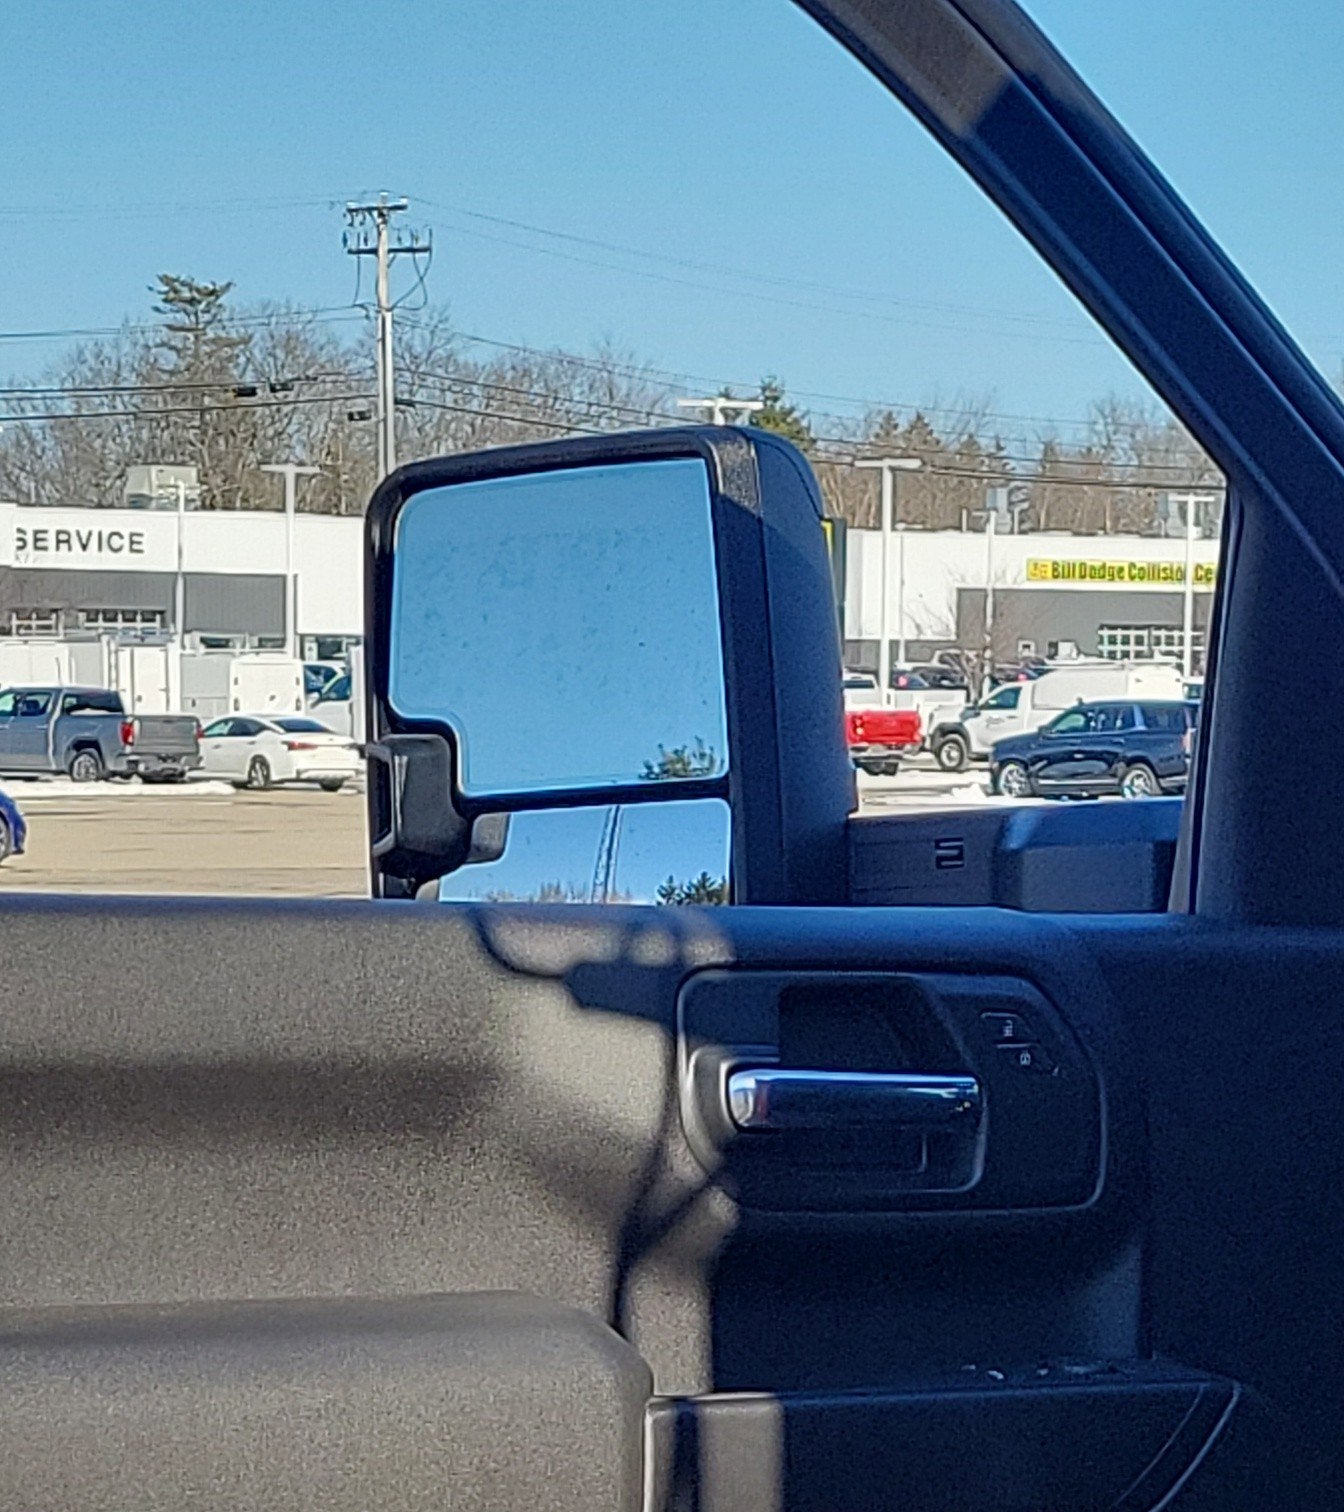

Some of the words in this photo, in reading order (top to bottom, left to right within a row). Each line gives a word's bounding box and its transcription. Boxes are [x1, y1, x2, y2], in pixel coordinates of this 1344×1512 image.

[15, 527, 145, 554] SERVICE
[1051, 560, 1077, 580] Bill
[1078, 561, 1126, 582] Dodge
[1127, 561, 1187, 582] Collisio
